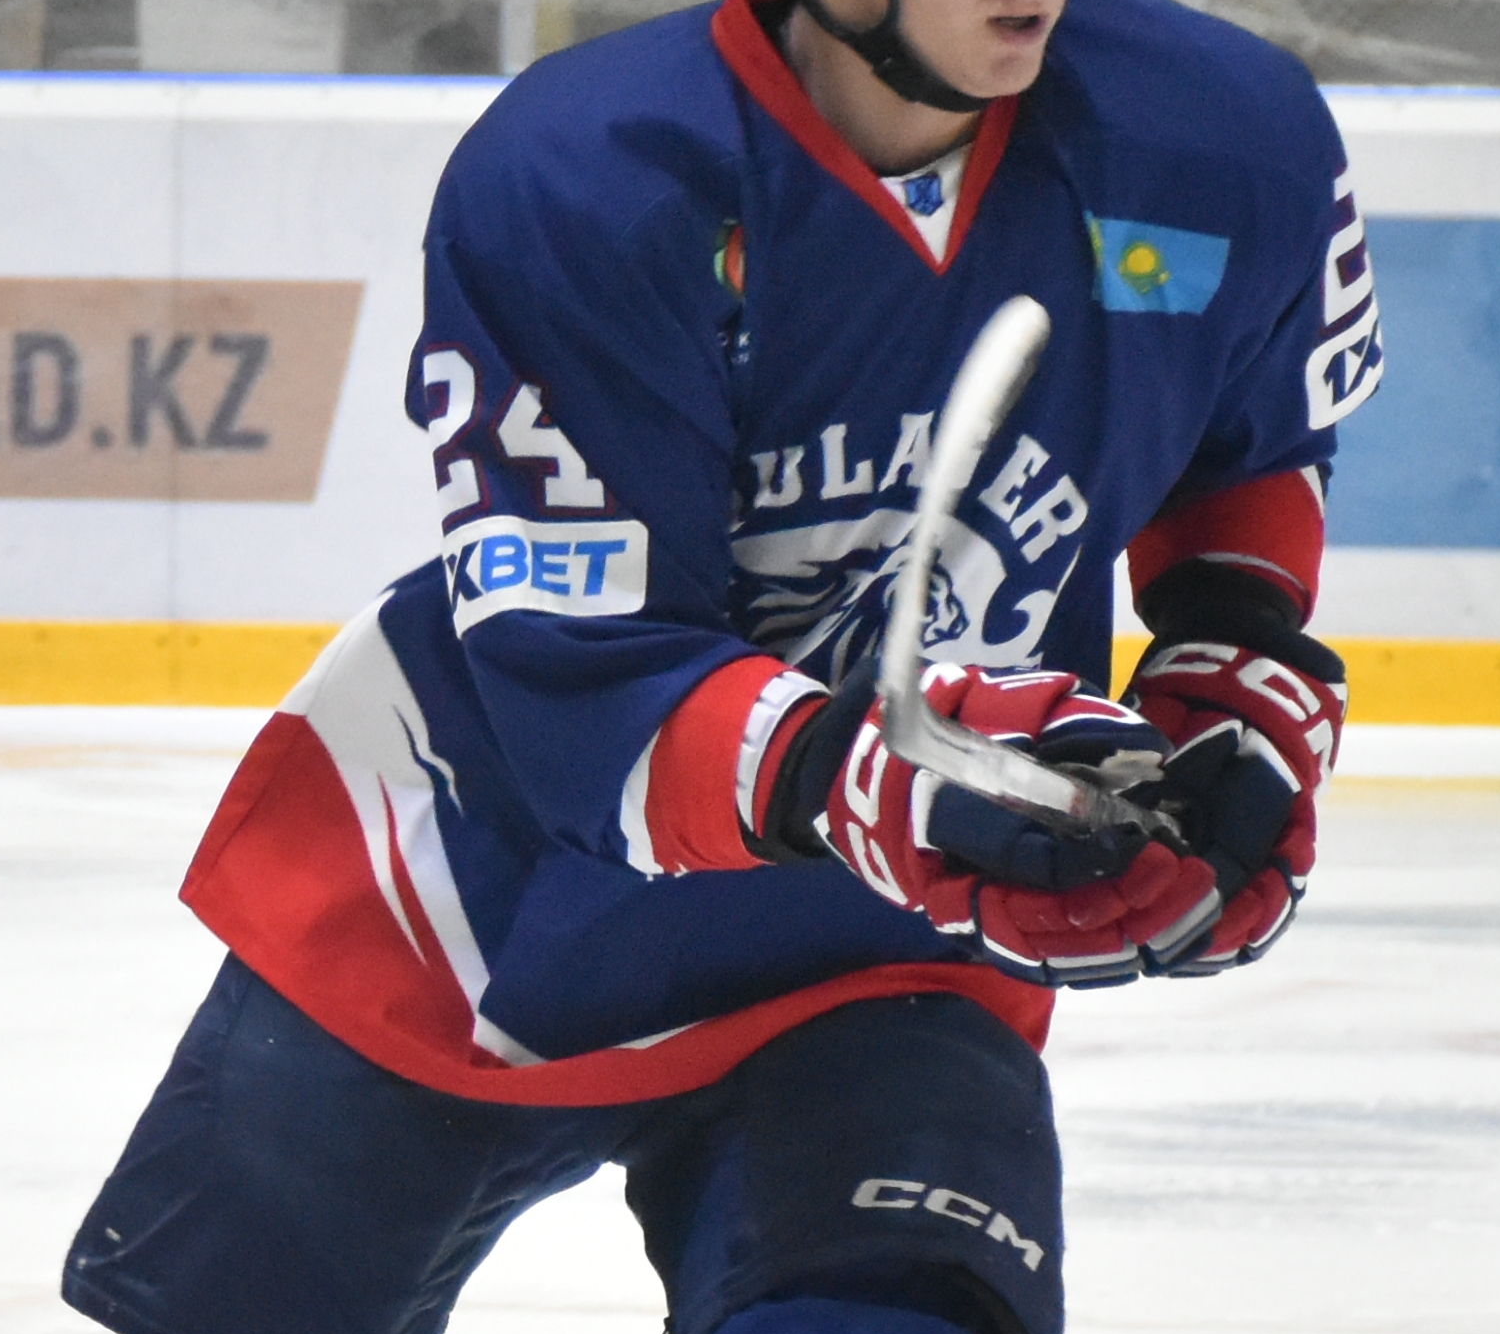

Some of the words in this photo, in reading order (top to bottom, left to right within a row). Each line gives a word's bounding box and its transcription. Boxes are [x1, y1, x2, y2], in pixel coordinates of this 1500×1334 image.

[422, 349, 606, 508] 24
[734, 410, 1090, 565] ULAER
[447, 533, 628, 605] XBET
[853, 1177, 1045, 1272] CCM
